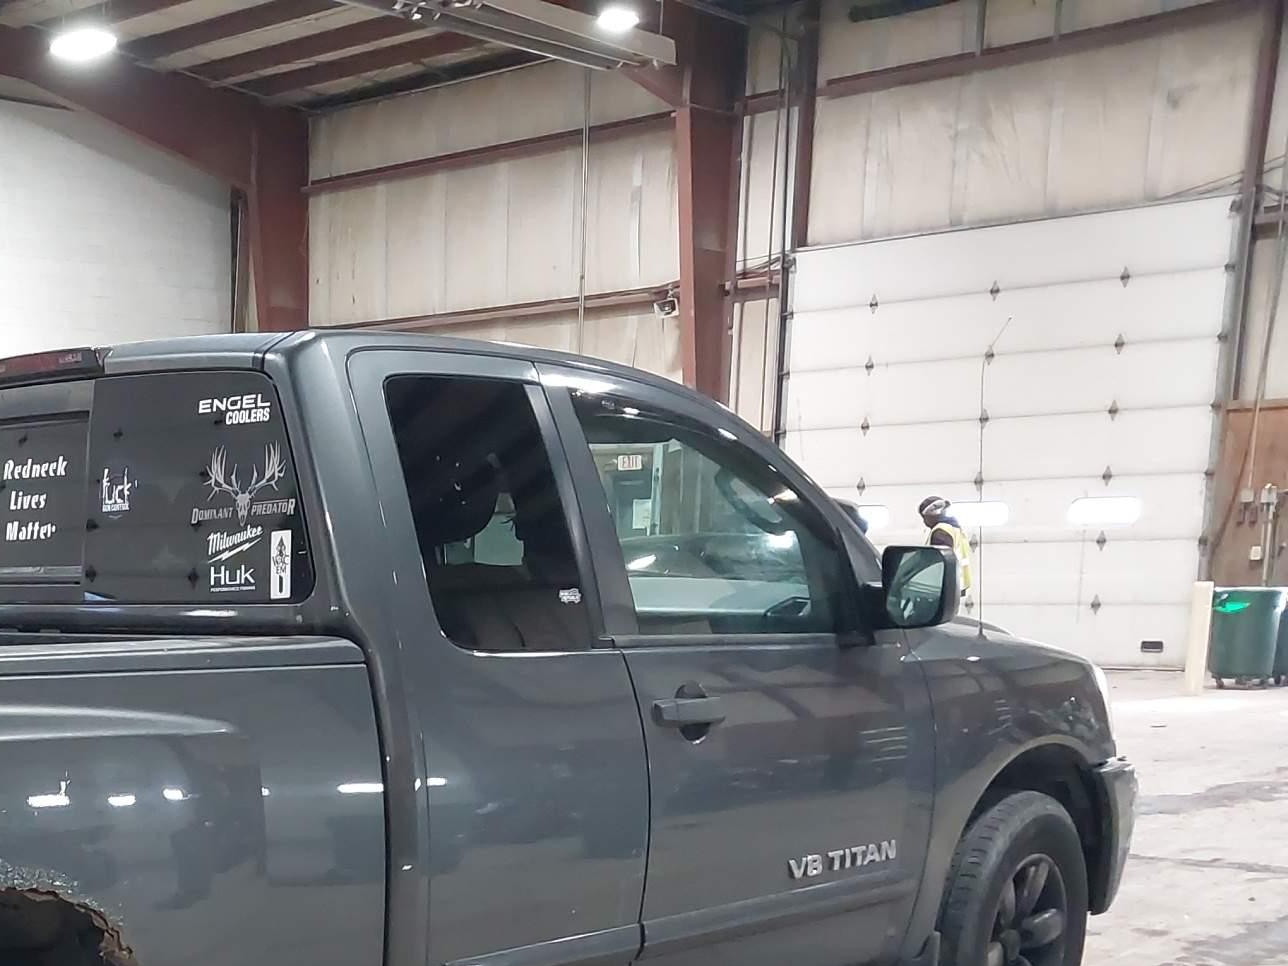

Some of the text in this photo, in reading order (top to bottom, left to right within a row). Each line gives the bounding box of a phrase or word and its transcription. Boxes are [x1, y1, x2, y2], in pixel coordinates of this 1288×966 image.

[198, 394, 271, 413] ENGEL
[225, 407, 271, 425] COOLERS
[3, 455, 68, 480] Redneck
[10, 490, 47, 510] Lives
[191, 498, 296, 524] DOMINANT PREDATOR
[5, 521, 56, 541] Matter
[207, 524, 262, 556] Milwaukee
[789, 840, 897, 879] V8 TITAN
